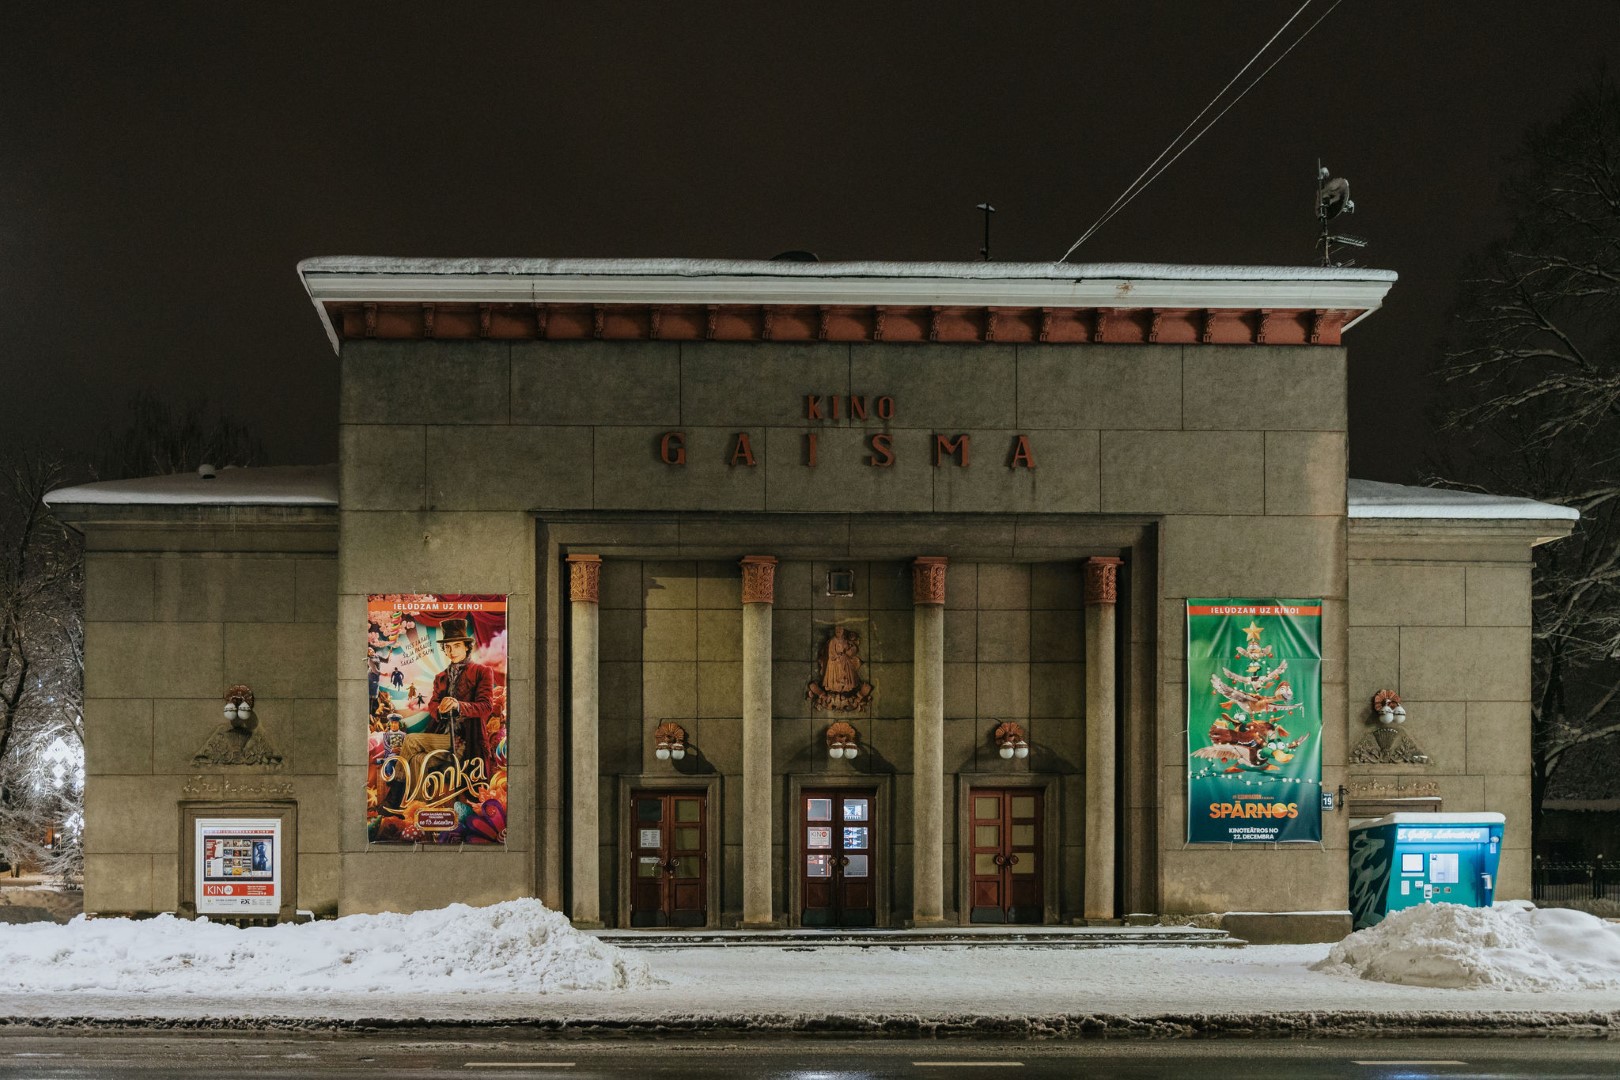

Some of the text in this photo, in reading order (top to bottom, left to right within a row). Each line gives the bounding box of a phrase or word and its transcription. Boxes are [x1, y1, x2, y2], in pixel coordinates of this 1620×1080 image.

[807, 394, 896, 421] KINO
[660, 432, 1036, 469] GAISMA
[381, 749, 490, 810] Vonka
[1209, 800, 1299, 819] SPĀRNOS
[1323, 796, 1332, 806] 19
[1228, 826, 1268, 834] KINOTEĀTROS
[207, 884, 234, 896] KINO
